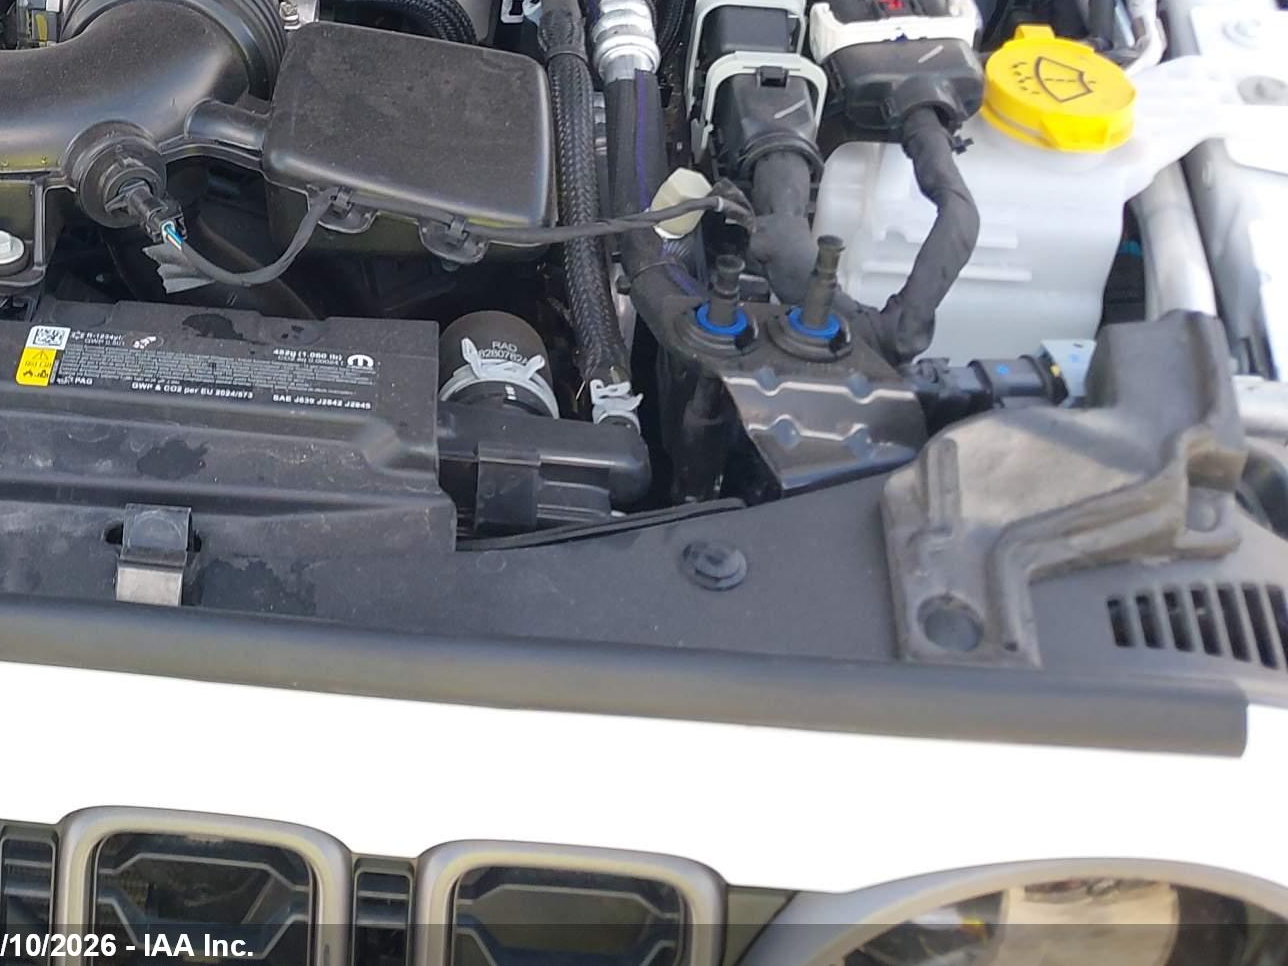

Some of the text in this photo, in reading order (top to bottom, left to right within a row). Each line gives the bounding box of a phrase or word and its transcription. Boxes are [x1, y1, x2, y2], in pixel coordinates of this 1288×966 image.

[492, 340, 518, 353] RAD
[132, 382, 153, 390] GWP
[184, 387, 199, 395] per
